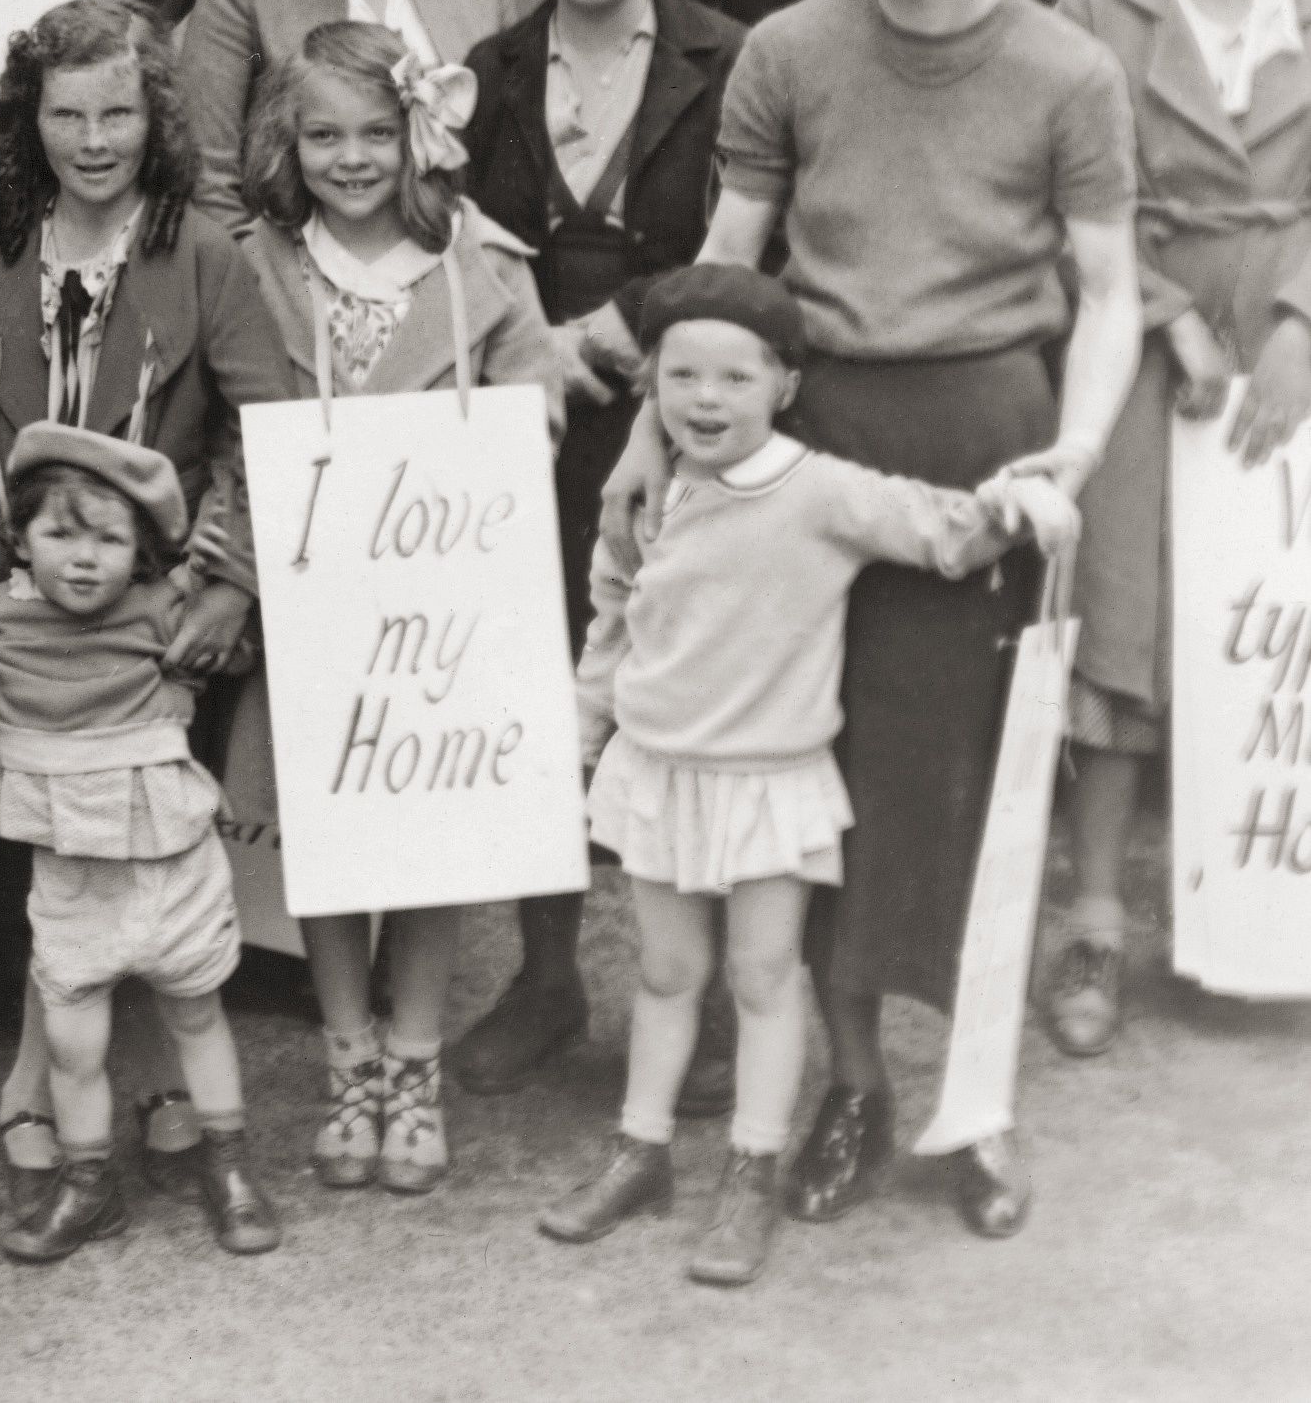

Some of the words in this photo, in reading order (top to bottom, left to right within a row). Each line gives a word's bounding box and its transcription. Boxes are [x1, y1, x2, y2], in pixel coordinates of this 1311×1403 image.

[289, 456, 333, 574] I
[368, 459, 516, 561] love
[368, 612, 478, 704] my
[329, 694, 525, 795] Home
